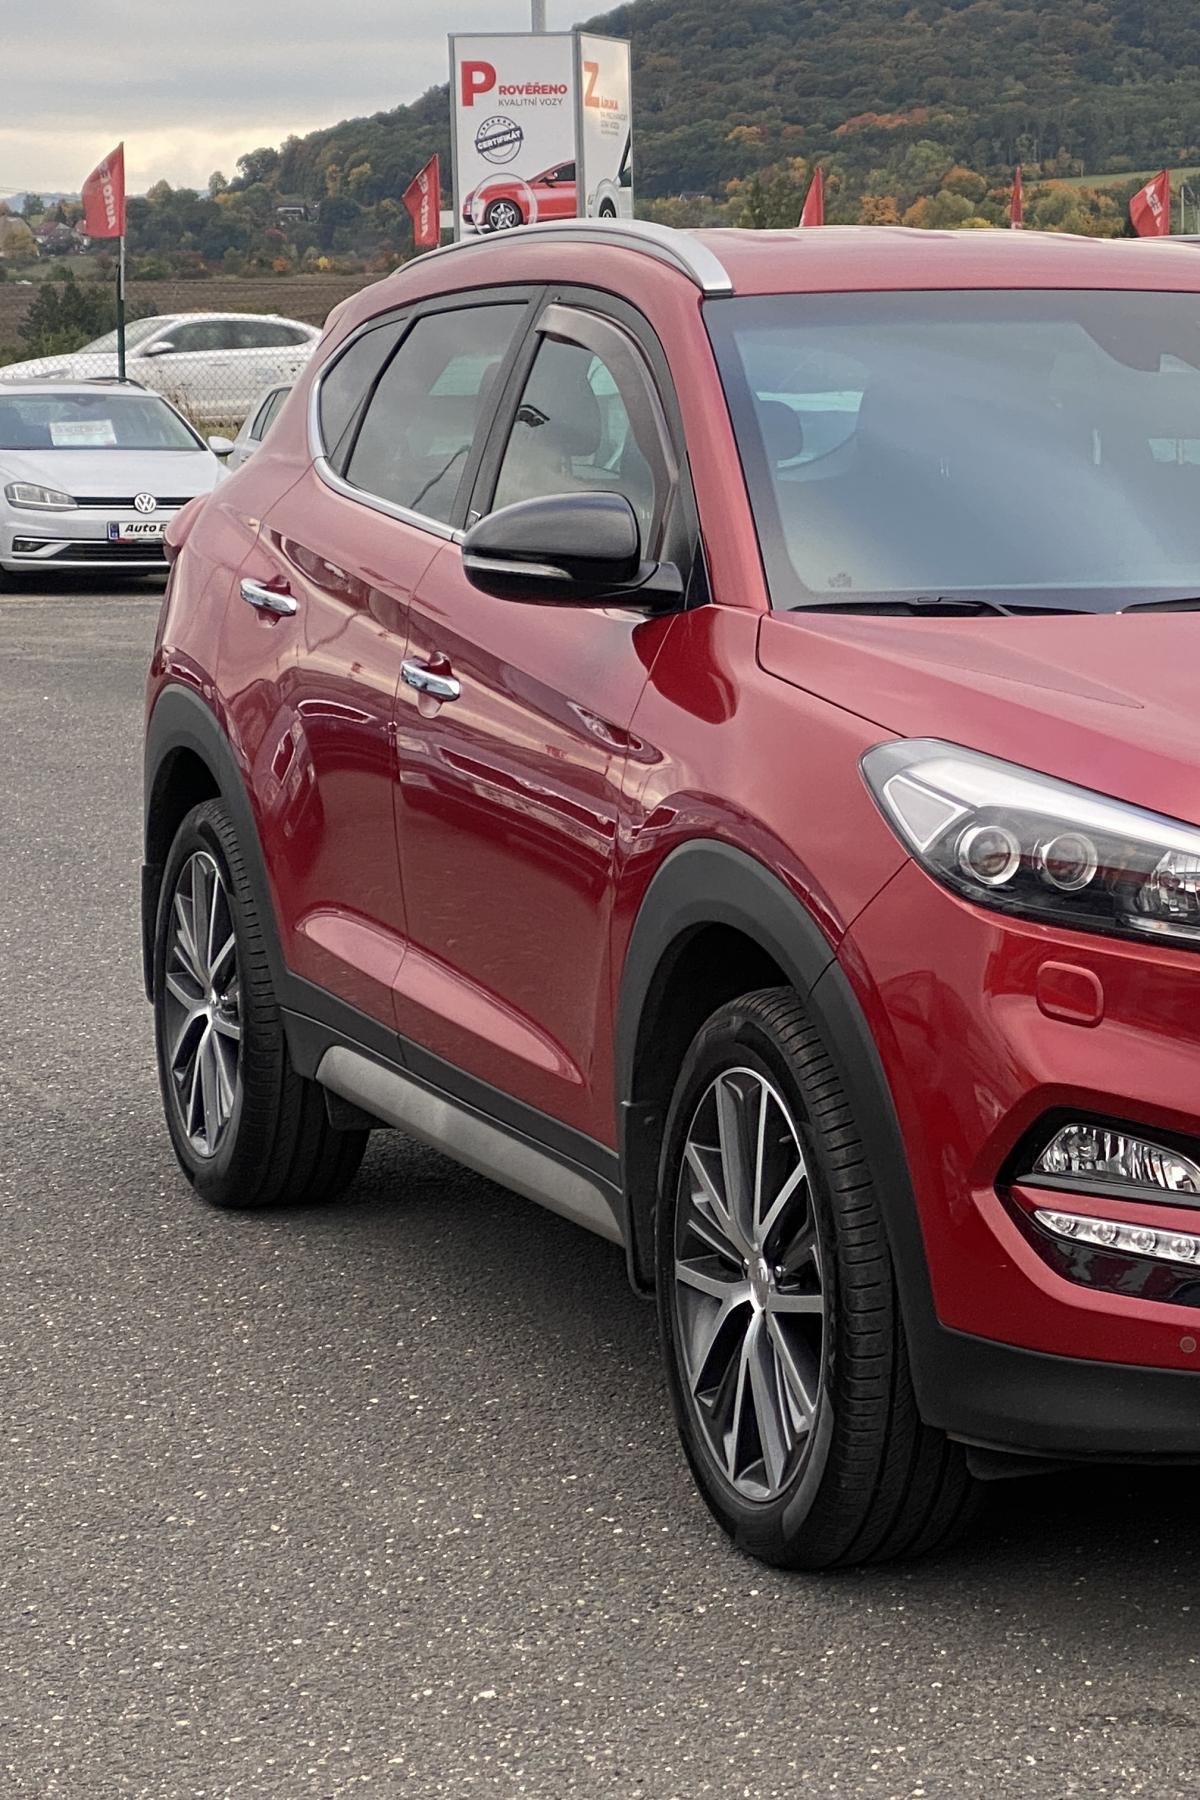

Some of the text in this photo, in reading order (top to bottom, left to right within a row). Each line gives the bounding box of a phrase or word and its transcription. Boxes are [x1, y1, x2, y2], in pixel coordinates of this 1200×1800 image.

[498, 97, 563, 107] KVALITNÍ VOZY
[478, 129, 521, 150] CERTIFIKÁT
[125, 524, 157, 533] Auto
